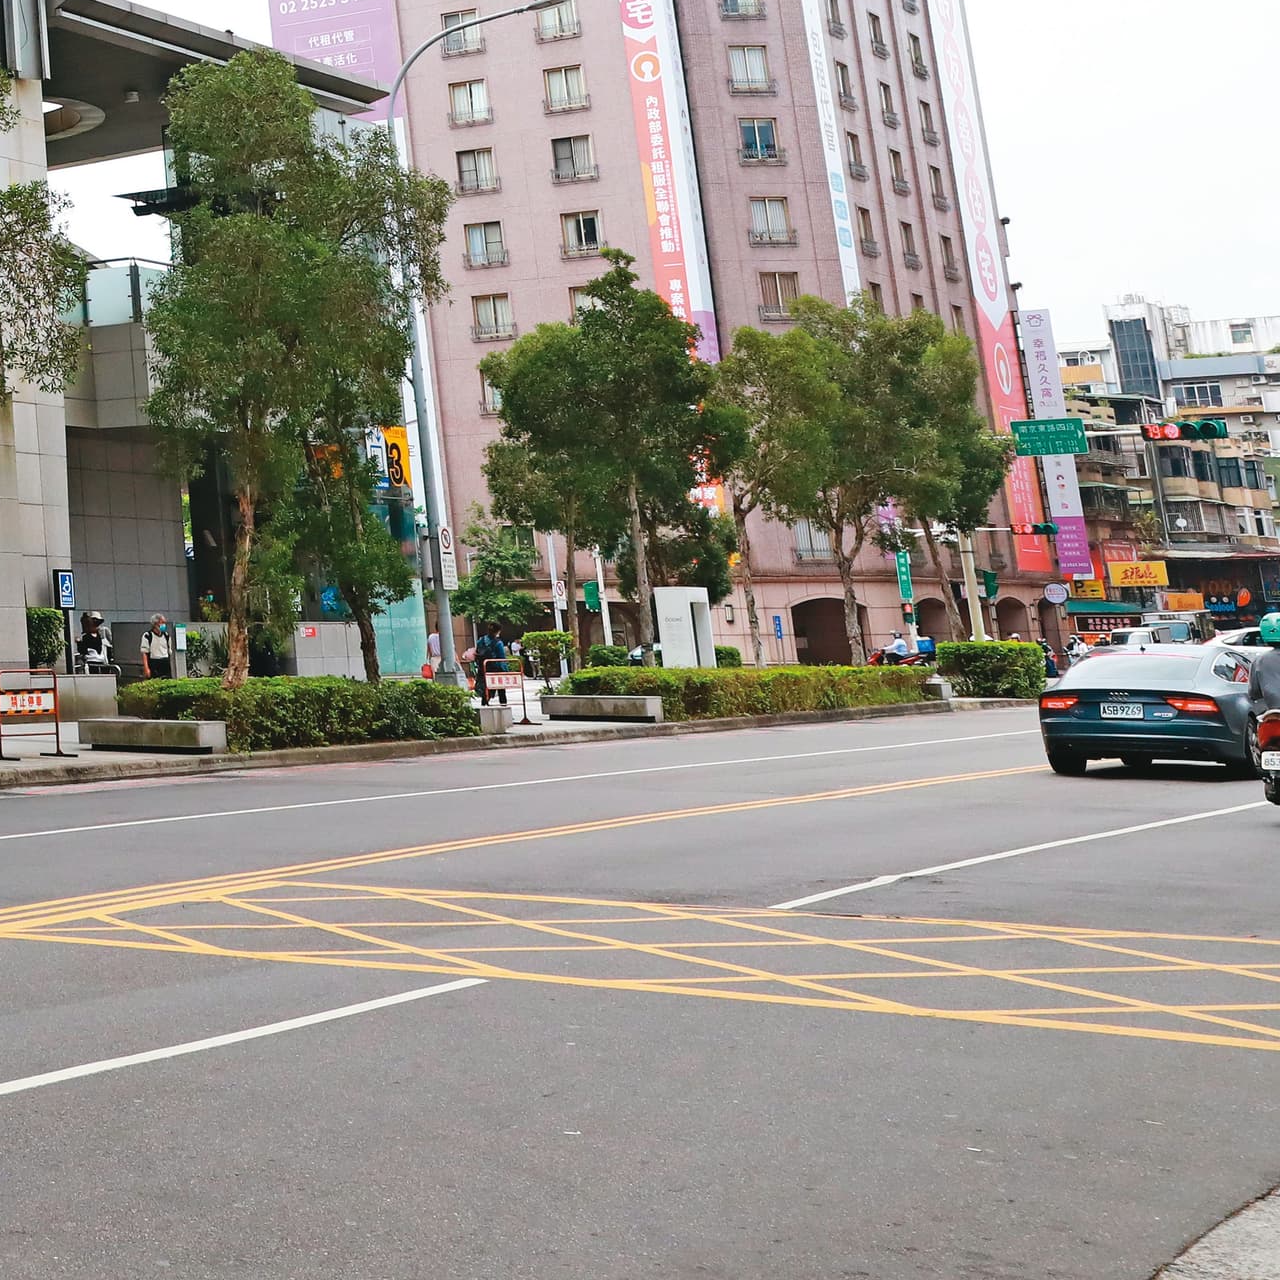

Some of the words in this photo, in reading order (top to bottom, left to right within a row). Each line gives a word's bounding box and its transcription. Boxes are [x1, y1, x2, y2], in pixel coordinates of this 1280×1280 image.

[279, 1, 297, 15] 02
[309, 30, 354, 48] 代租代管
[388, 443, 406, 487] 3
